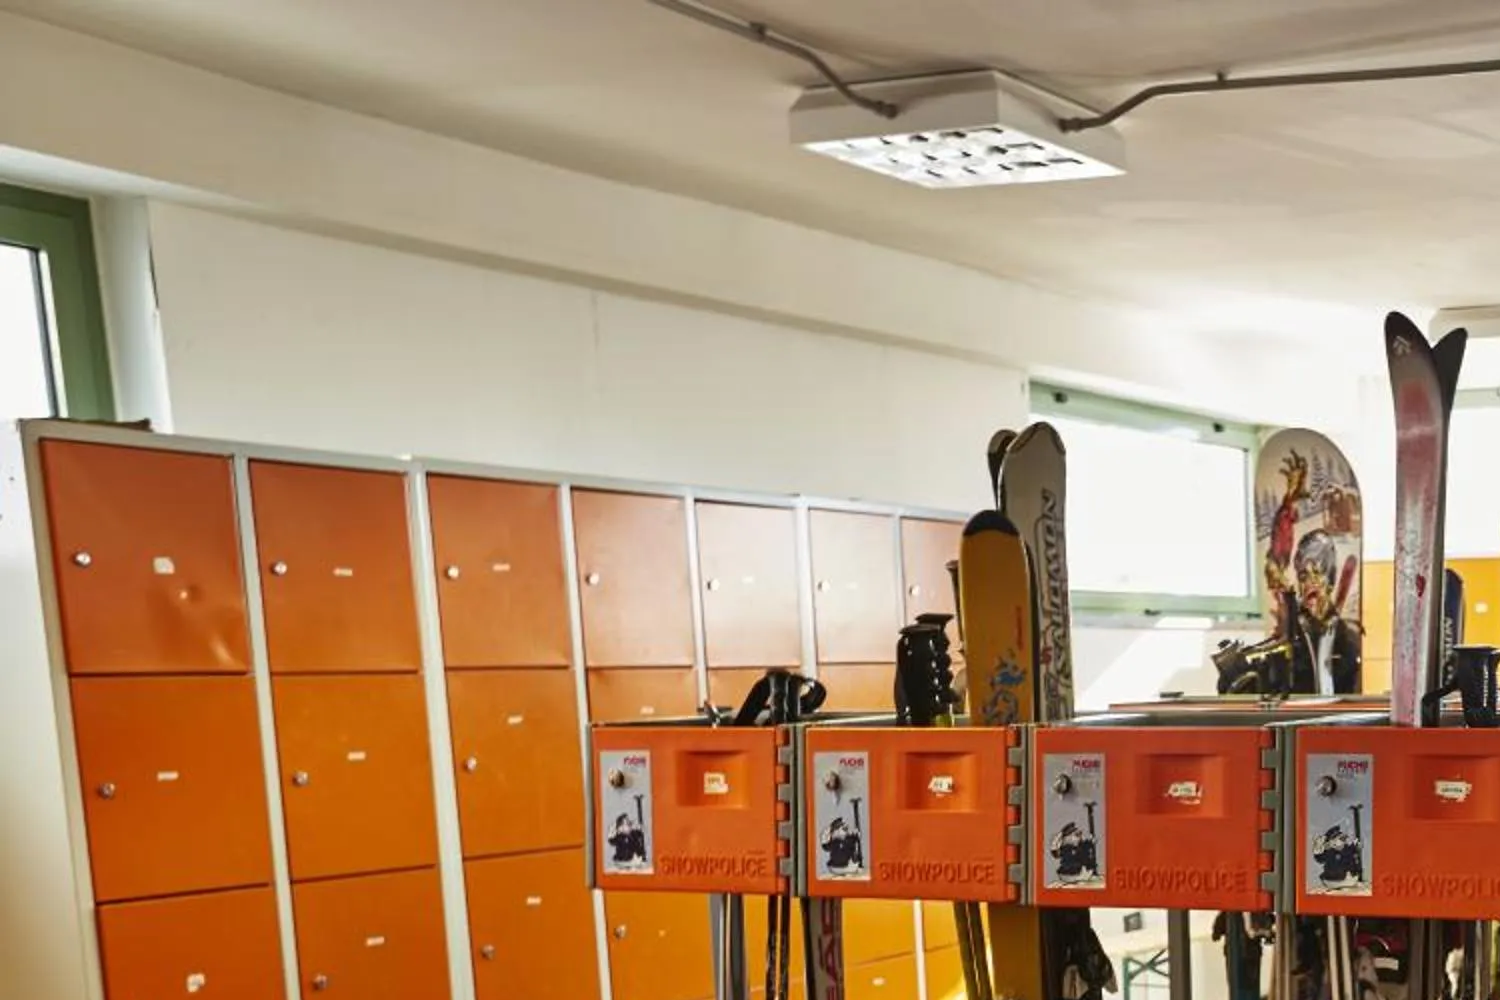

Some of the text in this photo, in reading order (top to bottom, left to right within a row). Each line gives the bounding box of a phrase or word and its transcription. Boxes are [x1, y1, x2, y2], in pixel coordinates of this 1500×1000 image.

[660, 855, 767, 878] SNOWPOLICE
[879, 862, 994, 885] SNOWPOLICE
[1113, 866, 1248, 894] SNOWPOLICE
